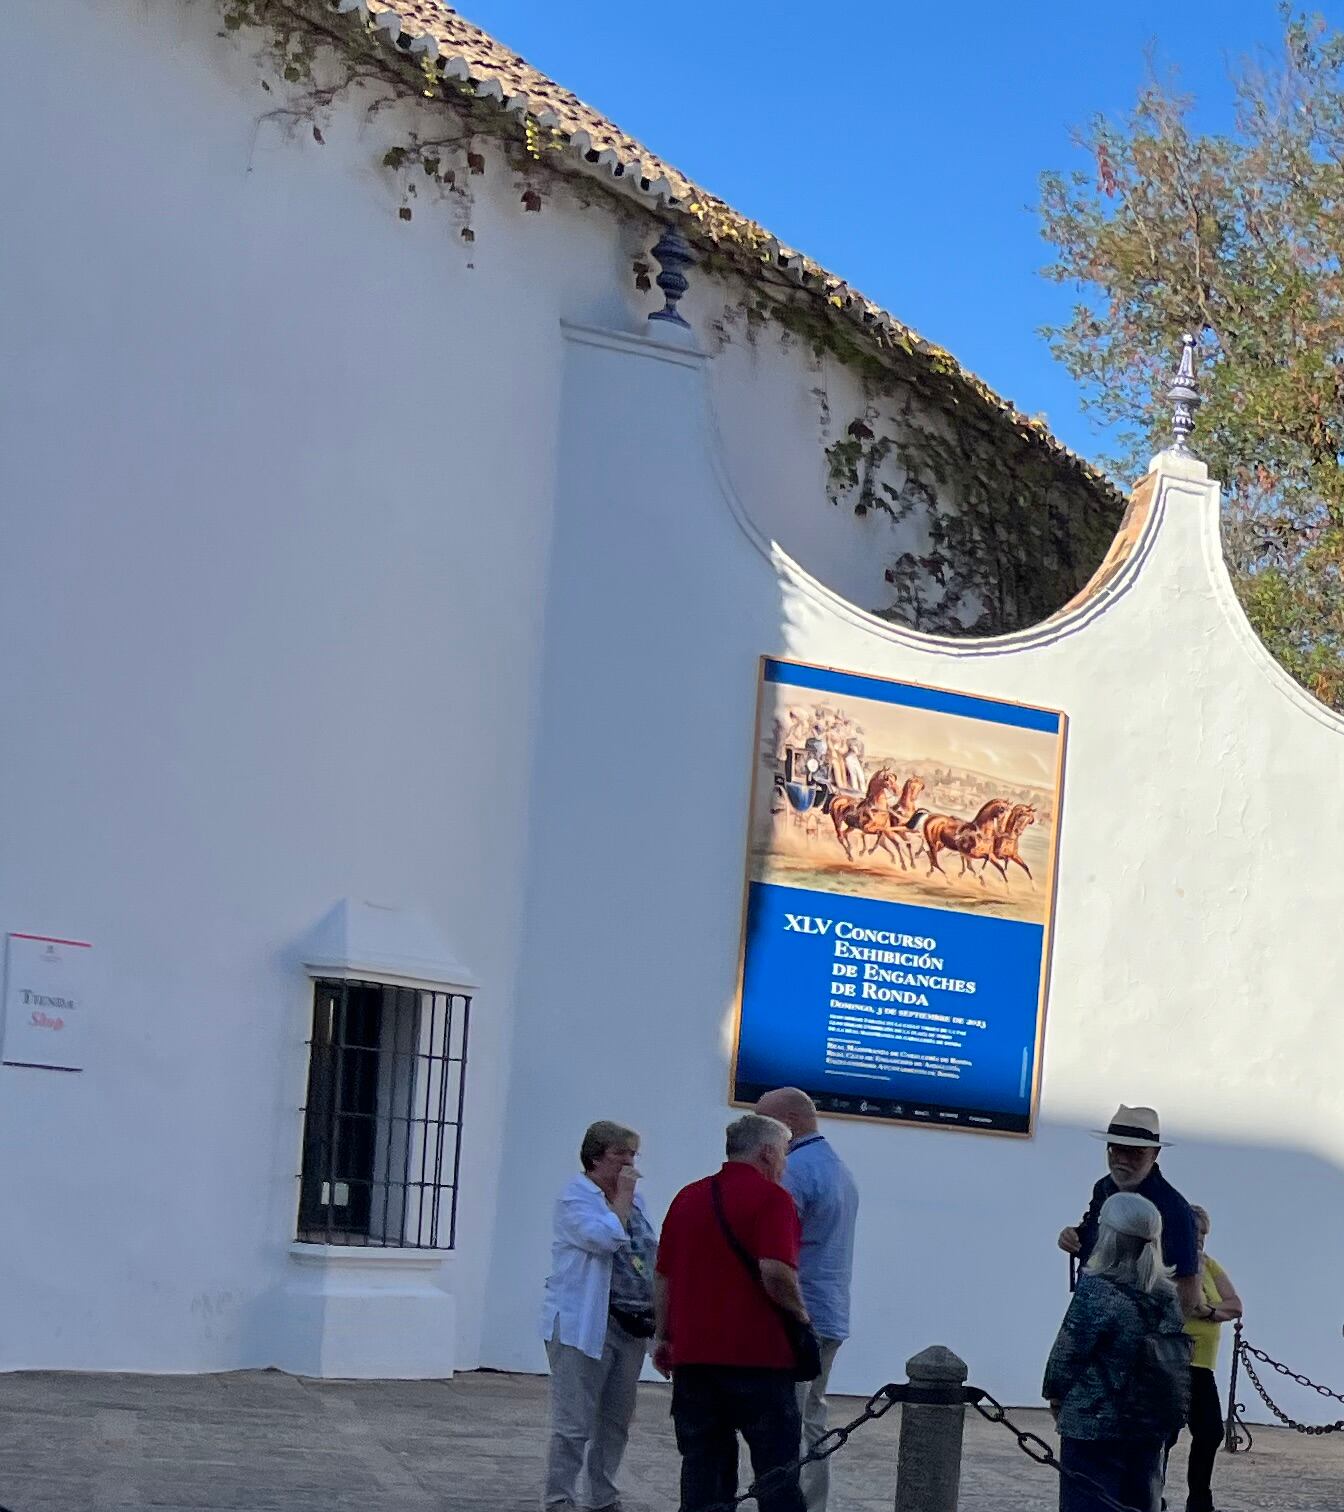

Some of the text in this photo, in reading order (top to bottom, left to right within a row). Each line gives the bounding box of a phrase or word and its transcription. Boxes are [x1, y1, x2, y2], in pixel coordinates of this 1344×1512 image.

[783, 913, 937, 951] XLV CONCURSO
[834, 940, 944, 971] EXHIBICIÓN
[831, 981, 929, 1006] DE RONDA
[832, 963, 977, 994] DE ENGANCHES
